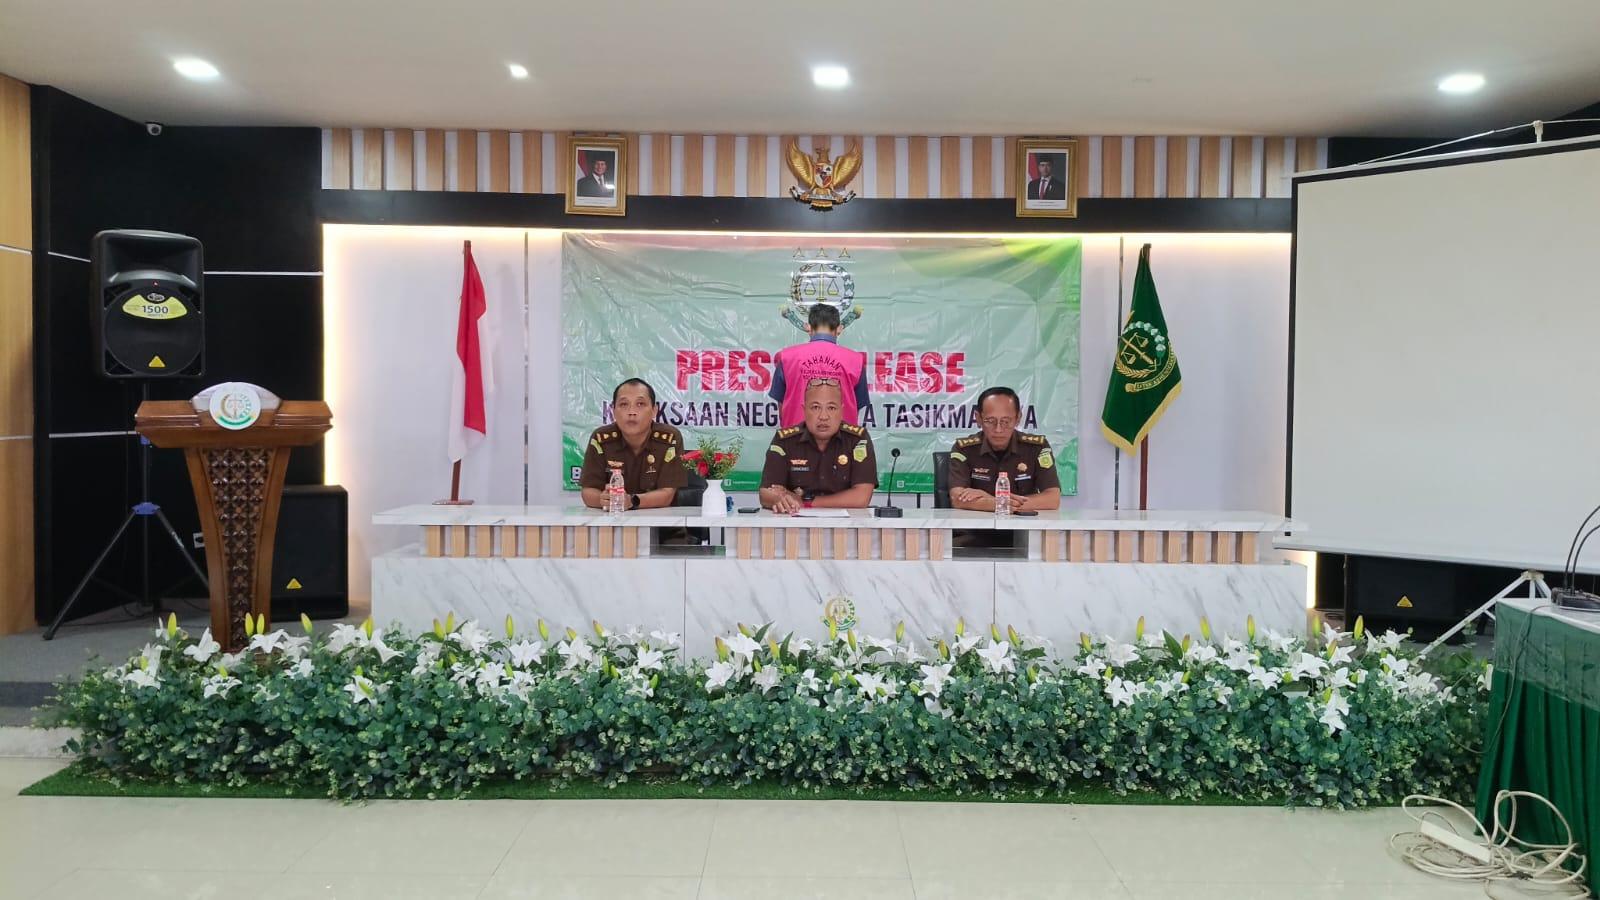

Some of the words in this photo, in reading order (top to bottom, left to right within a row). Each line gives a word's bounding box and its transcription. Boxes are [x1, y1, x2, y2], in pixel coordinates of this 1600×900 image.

[142, 305, 168, 314] 1500
[676, 350, 782, 392] PRES
[802, 355, 841, 371] TAHANAN
[602, 401, 729, 426] KKSAAN
[737, 402, 778, 427] NEG
[883, 403, 1038, 430] TASIKMAA
